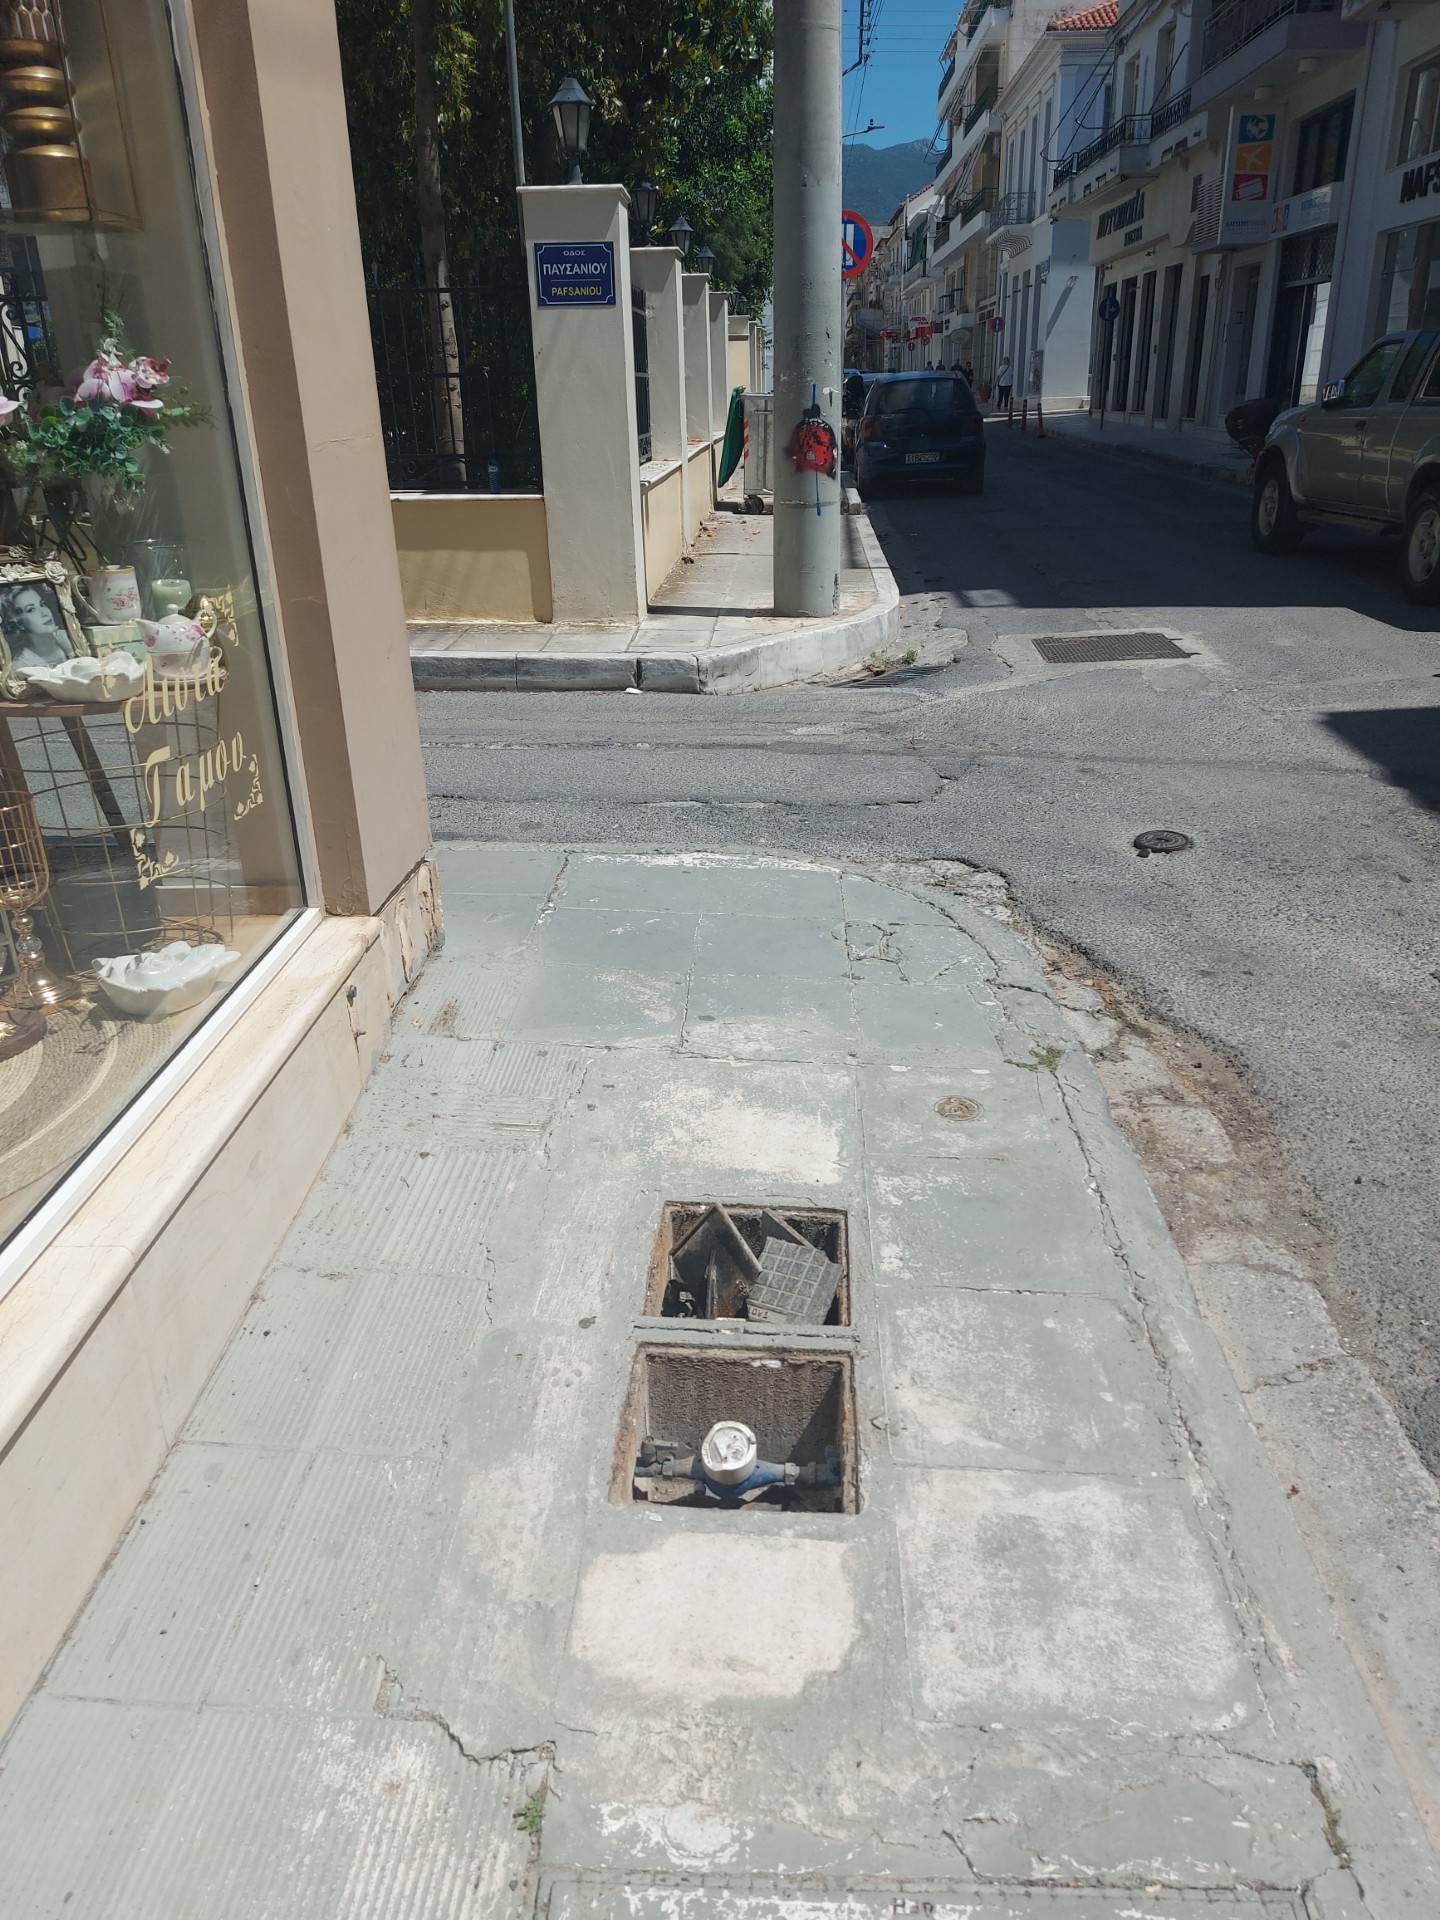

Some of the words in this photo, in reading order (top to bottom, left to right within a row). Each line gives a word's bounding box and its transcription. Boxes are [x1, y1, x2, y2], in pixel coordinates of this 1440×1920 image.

[543, 262, 608, 276] ΠΑΥΣΑΝΙΟΥ
[551, 286, 602, 297] PAFSANIOU
[144, 731, 247, 828] Γαμου
